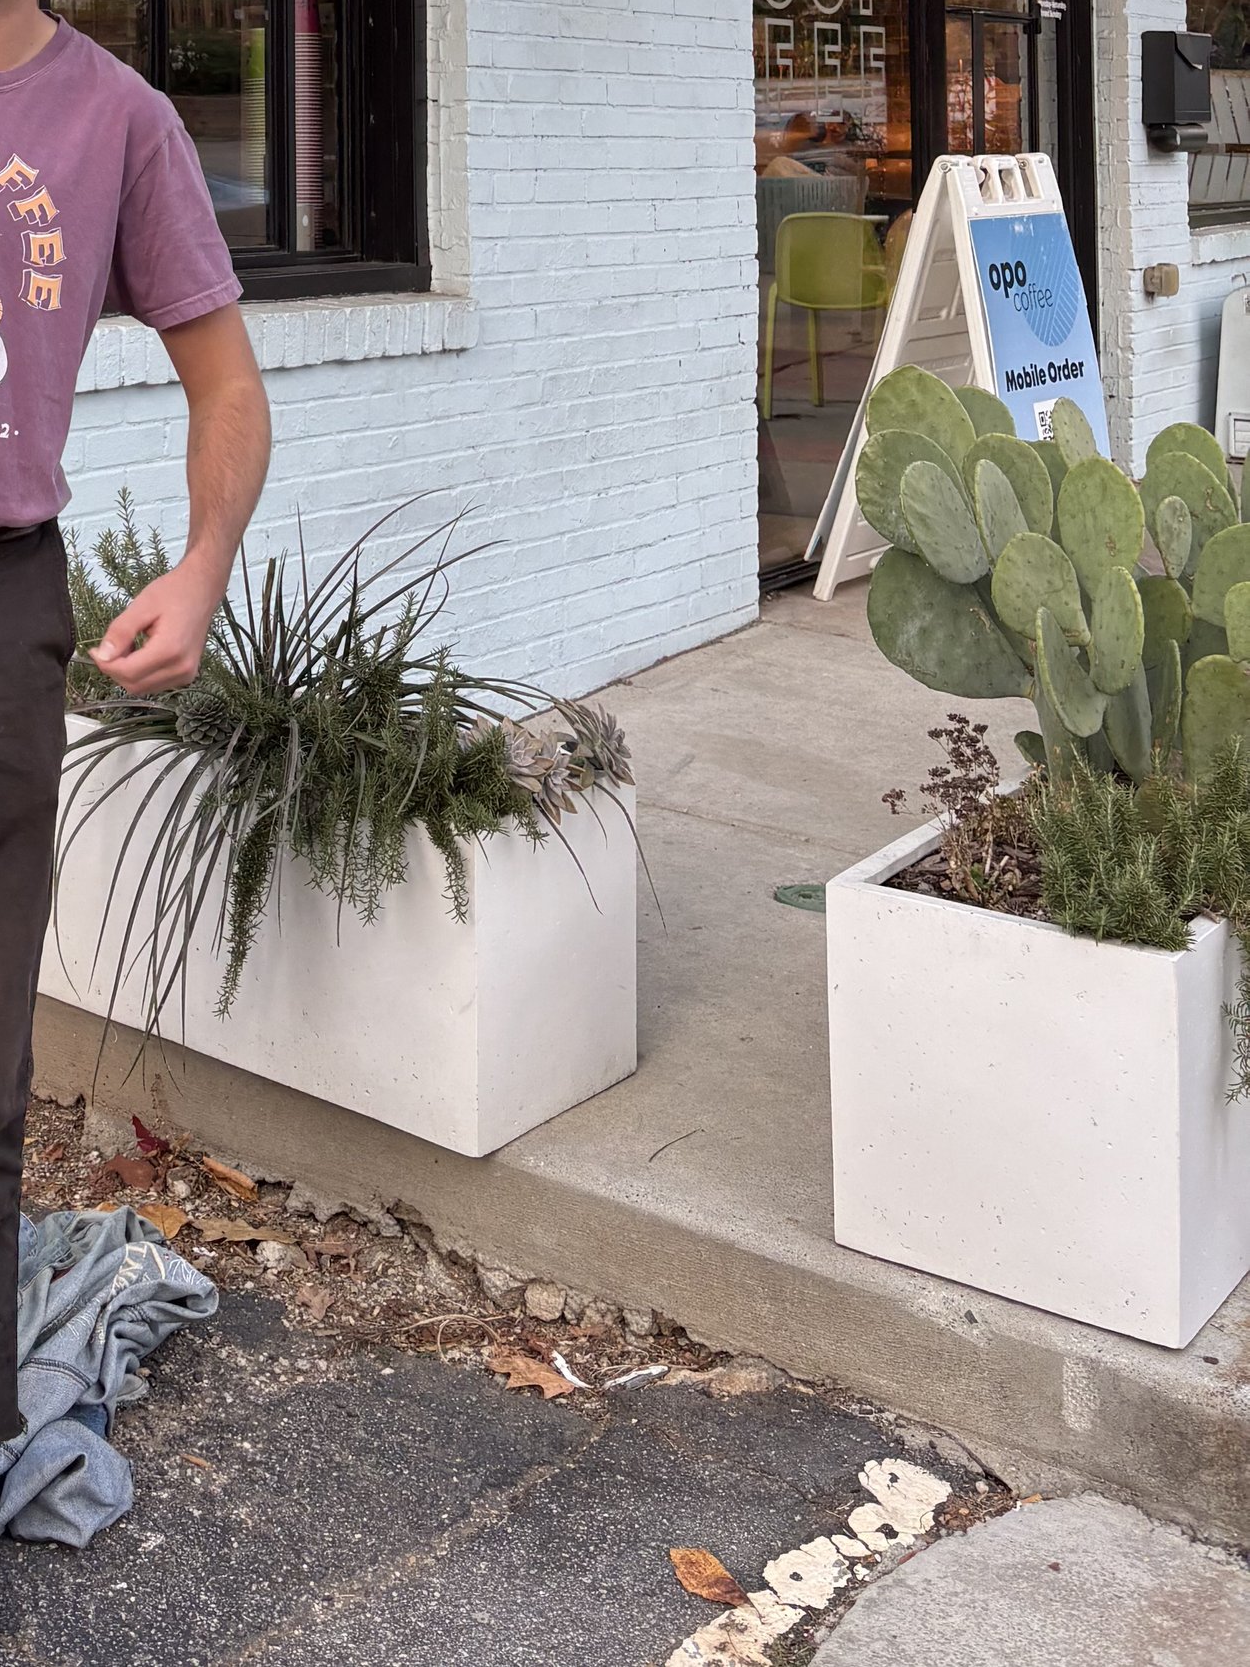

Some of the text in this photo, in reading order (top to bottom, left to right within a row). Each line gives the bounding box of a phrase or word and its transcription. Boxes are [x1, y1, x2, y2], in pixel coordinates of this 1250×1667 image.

[988, 260, 1026, 298] opo
[1013, 283, 1054, 312] coffee
[1005, 358, 1085, 393] Mobile Order
